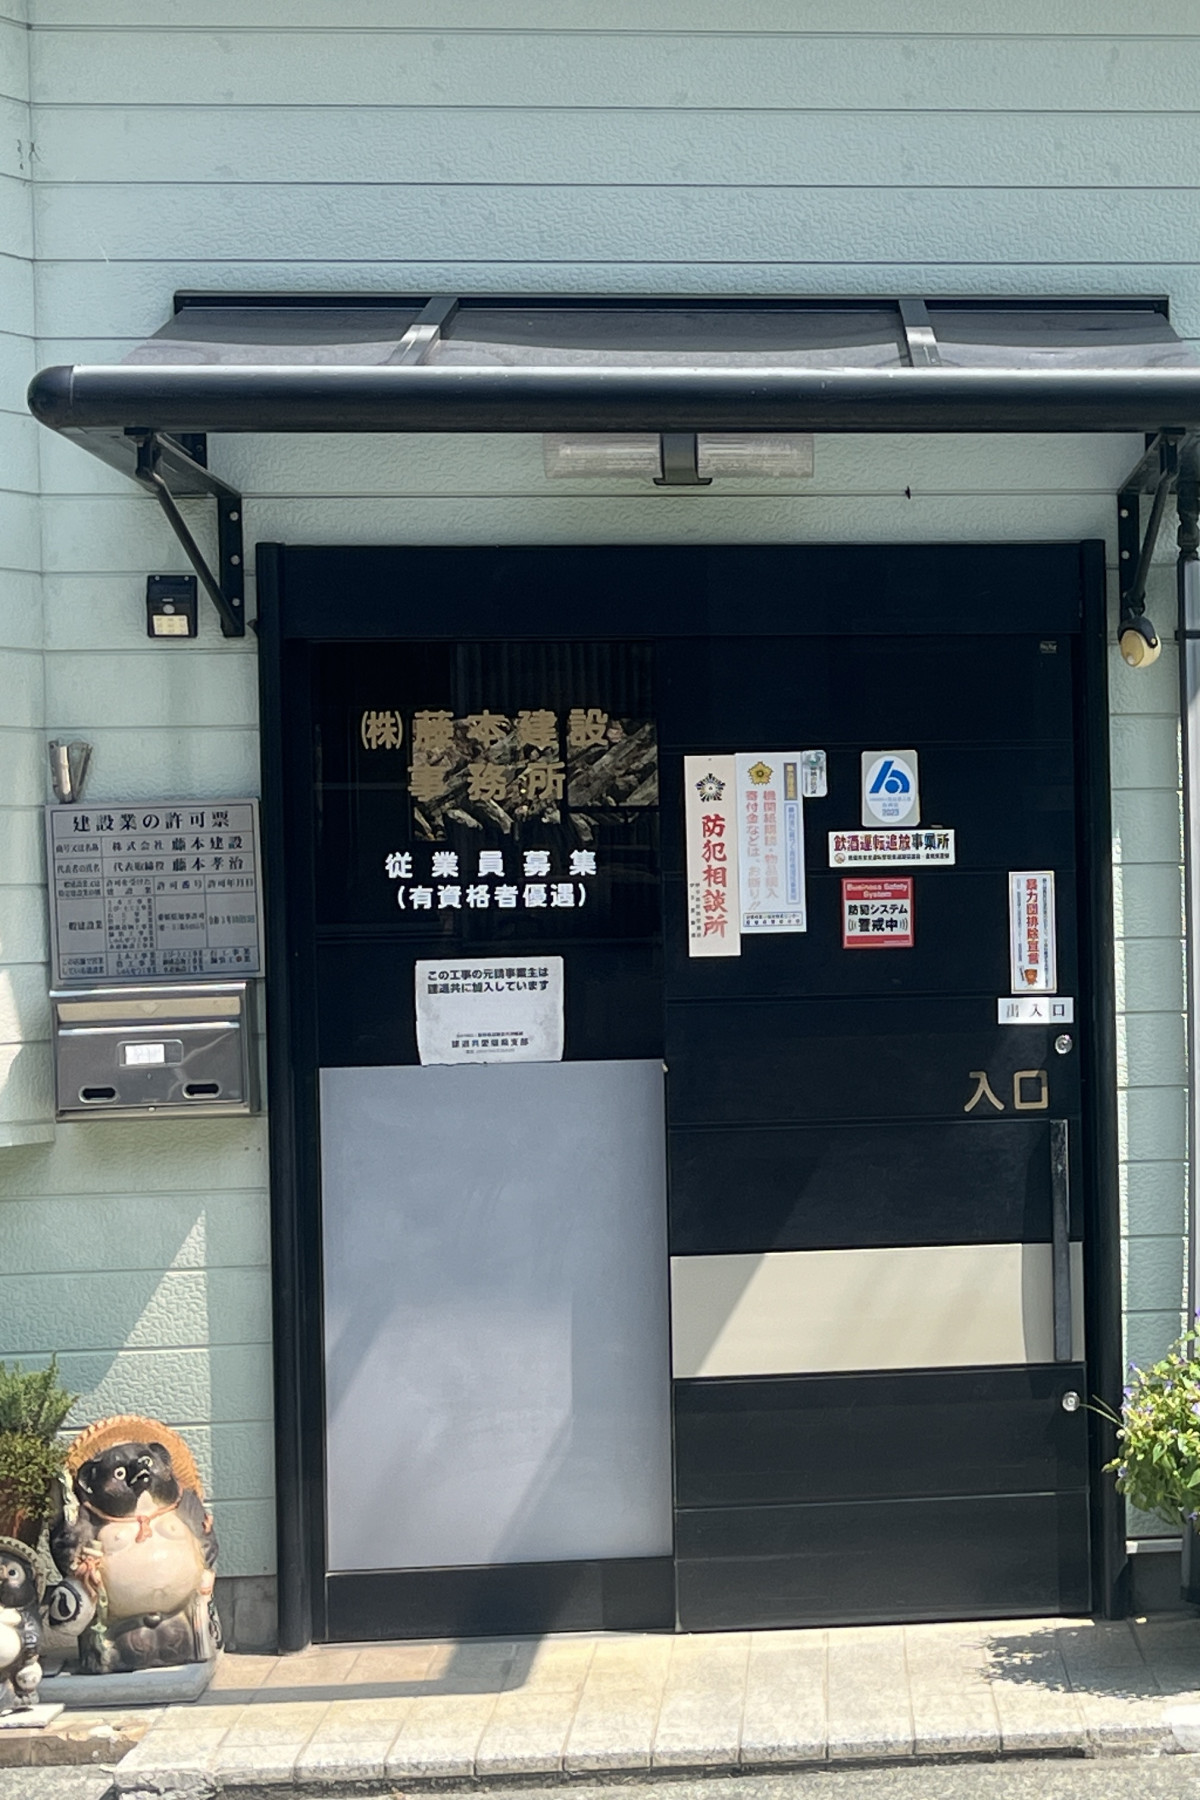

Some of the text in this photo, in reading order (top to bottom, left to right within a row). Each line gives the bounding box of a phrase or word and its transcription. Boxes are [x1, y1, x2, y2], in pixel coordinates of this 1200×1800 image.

[408, 761, 566, 802] 事務所
[73, 809, 230, 832] 建設業の許可票
[384, 849, 597, 879] 従業員募集
[701, 813, 729, 938] 防犯相談所
[1005, 1003, 1066, 1019] 出入口
[964, 1070, 1049, 1112] 入口
